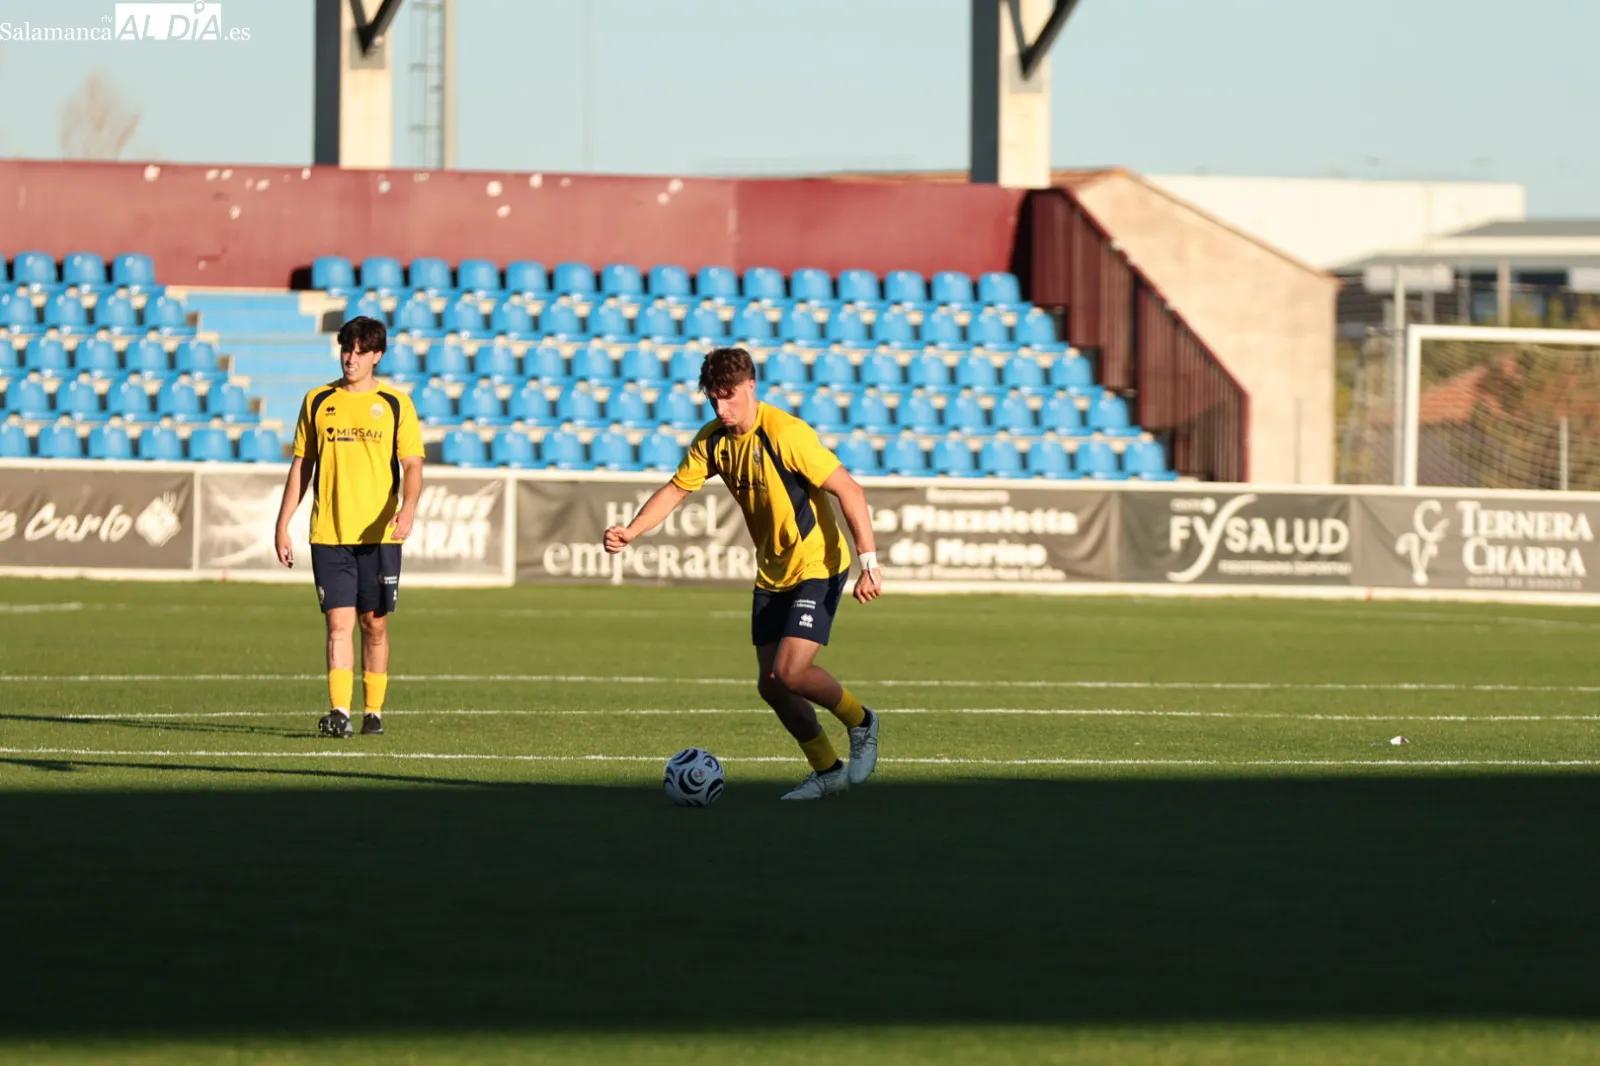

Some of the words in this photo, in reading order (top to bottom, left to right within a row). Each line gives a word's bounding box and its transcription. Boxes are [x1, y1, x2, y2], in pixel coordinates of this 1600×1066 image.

[336, 427, 383, 439] MIRSAN
[24, 502, 133, 542] Carlo
[1455, 500, 1594, 541] TERNERA
[1462, 536, 1587, 577] CHARRA
